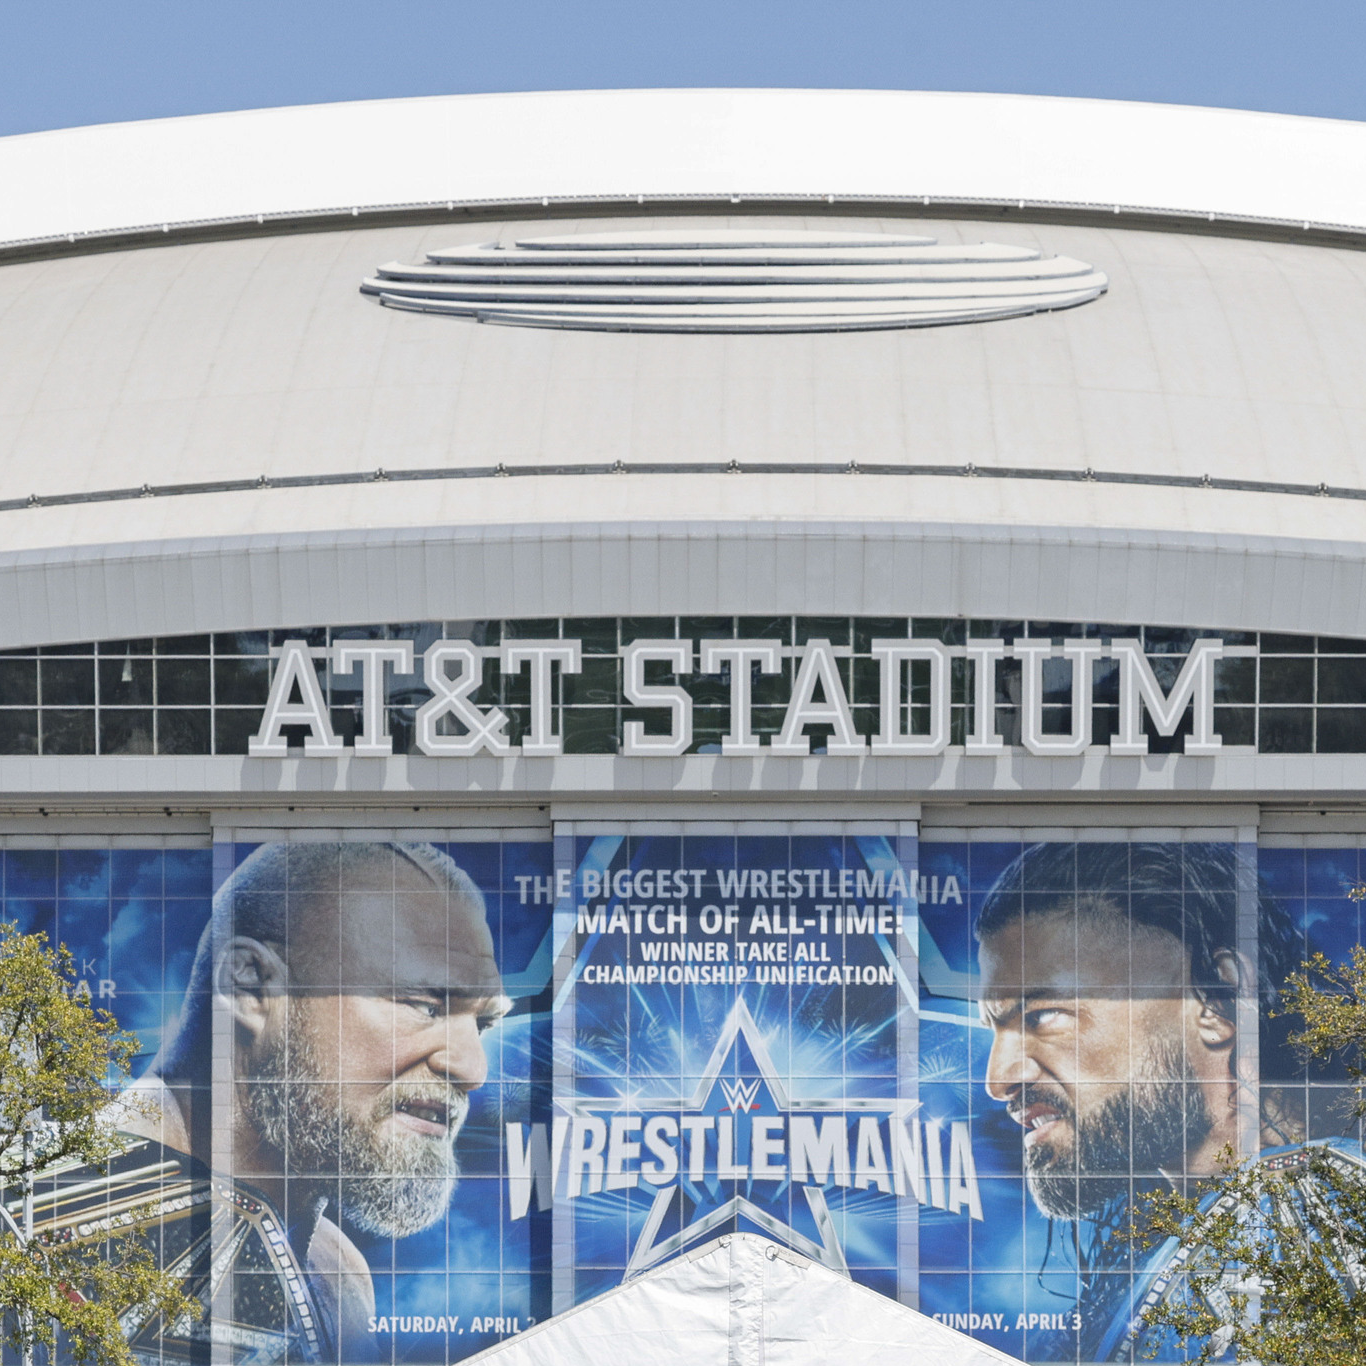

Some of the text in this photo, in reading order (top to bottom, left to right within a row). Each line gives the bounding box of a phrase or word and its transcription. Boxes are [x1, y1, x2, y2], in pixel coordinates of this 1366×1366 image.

[248, 637, 1223, 757] AT&T STADIUM
[515, 868, 963, 906] THE BIGGEST WRESTLEMANIA
[577, 904, 904, 935] MATCH OF ALL-TIME!
[640, 942, 831, 962] WINNER TAKE ALL
[582, 965, 895, 986] CHAMPIONSHIP UNIFICATION
[506, 1115, 985, 1222] WRESTLEMANIA
[367, 1315, 465, 1336] SATURDAY,
[470, 1316, 522, 1333] APRIL
[932, 1312, 1083, 1333] SUNDAY, APRIL 3
